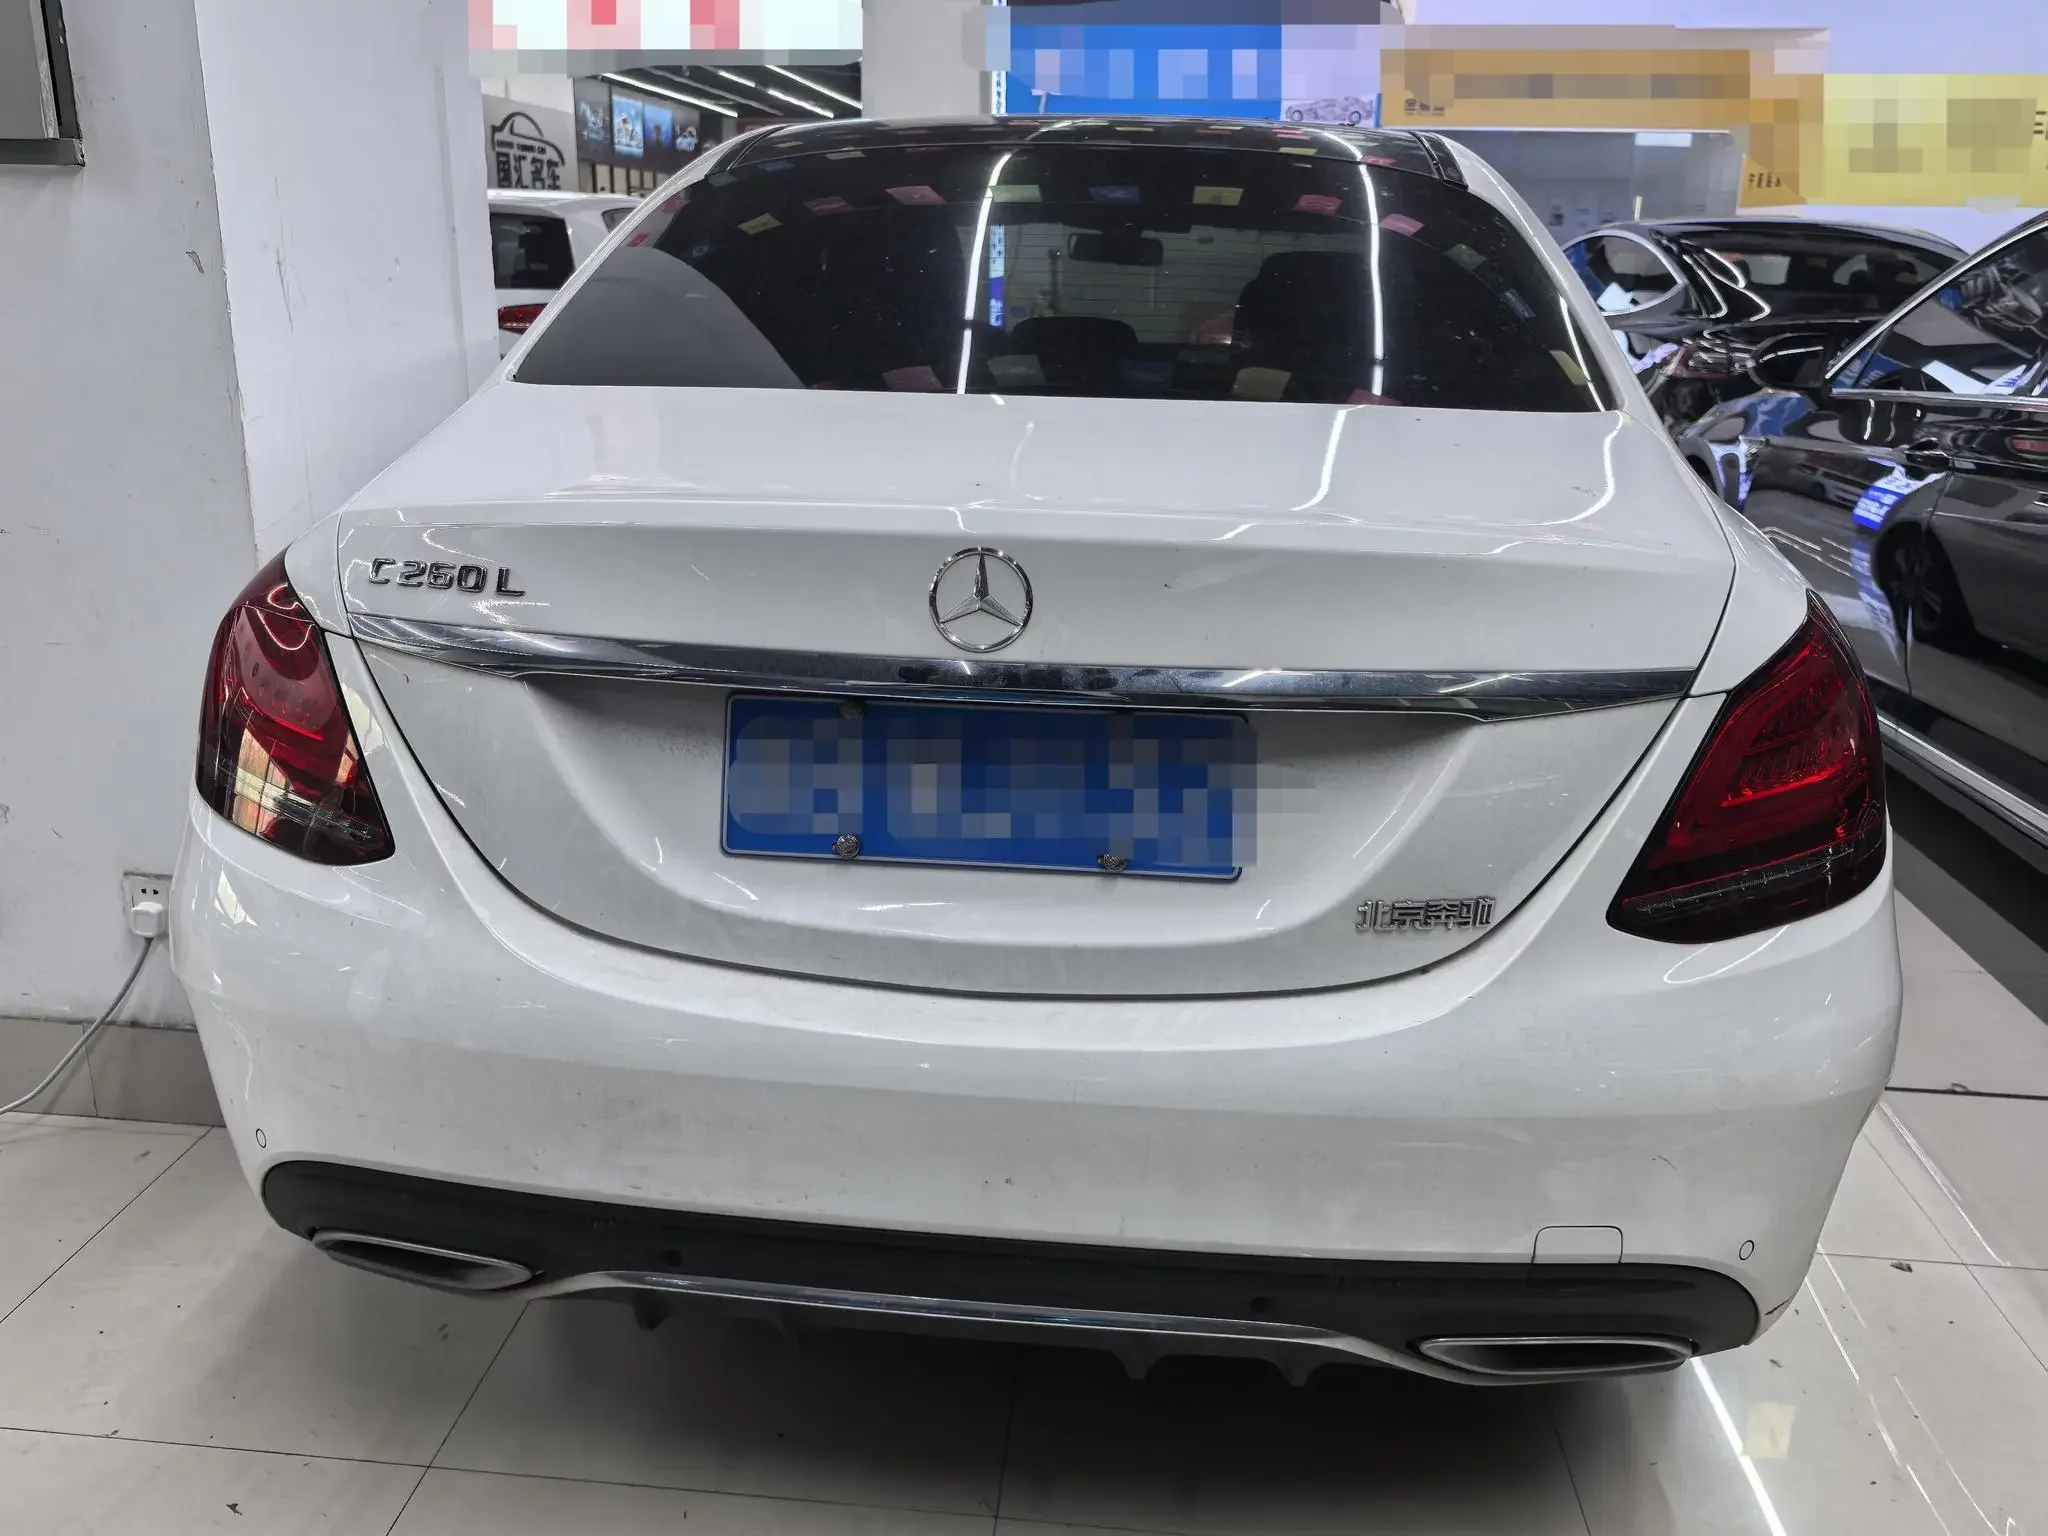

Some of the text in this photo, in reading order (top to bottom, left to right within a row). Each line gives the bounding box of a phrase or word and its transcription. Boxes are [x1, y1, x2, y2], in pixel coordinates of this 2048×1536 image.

[495, 567, 525, 597] L
[1356, 896, 1495, 931] 北京奔驰
